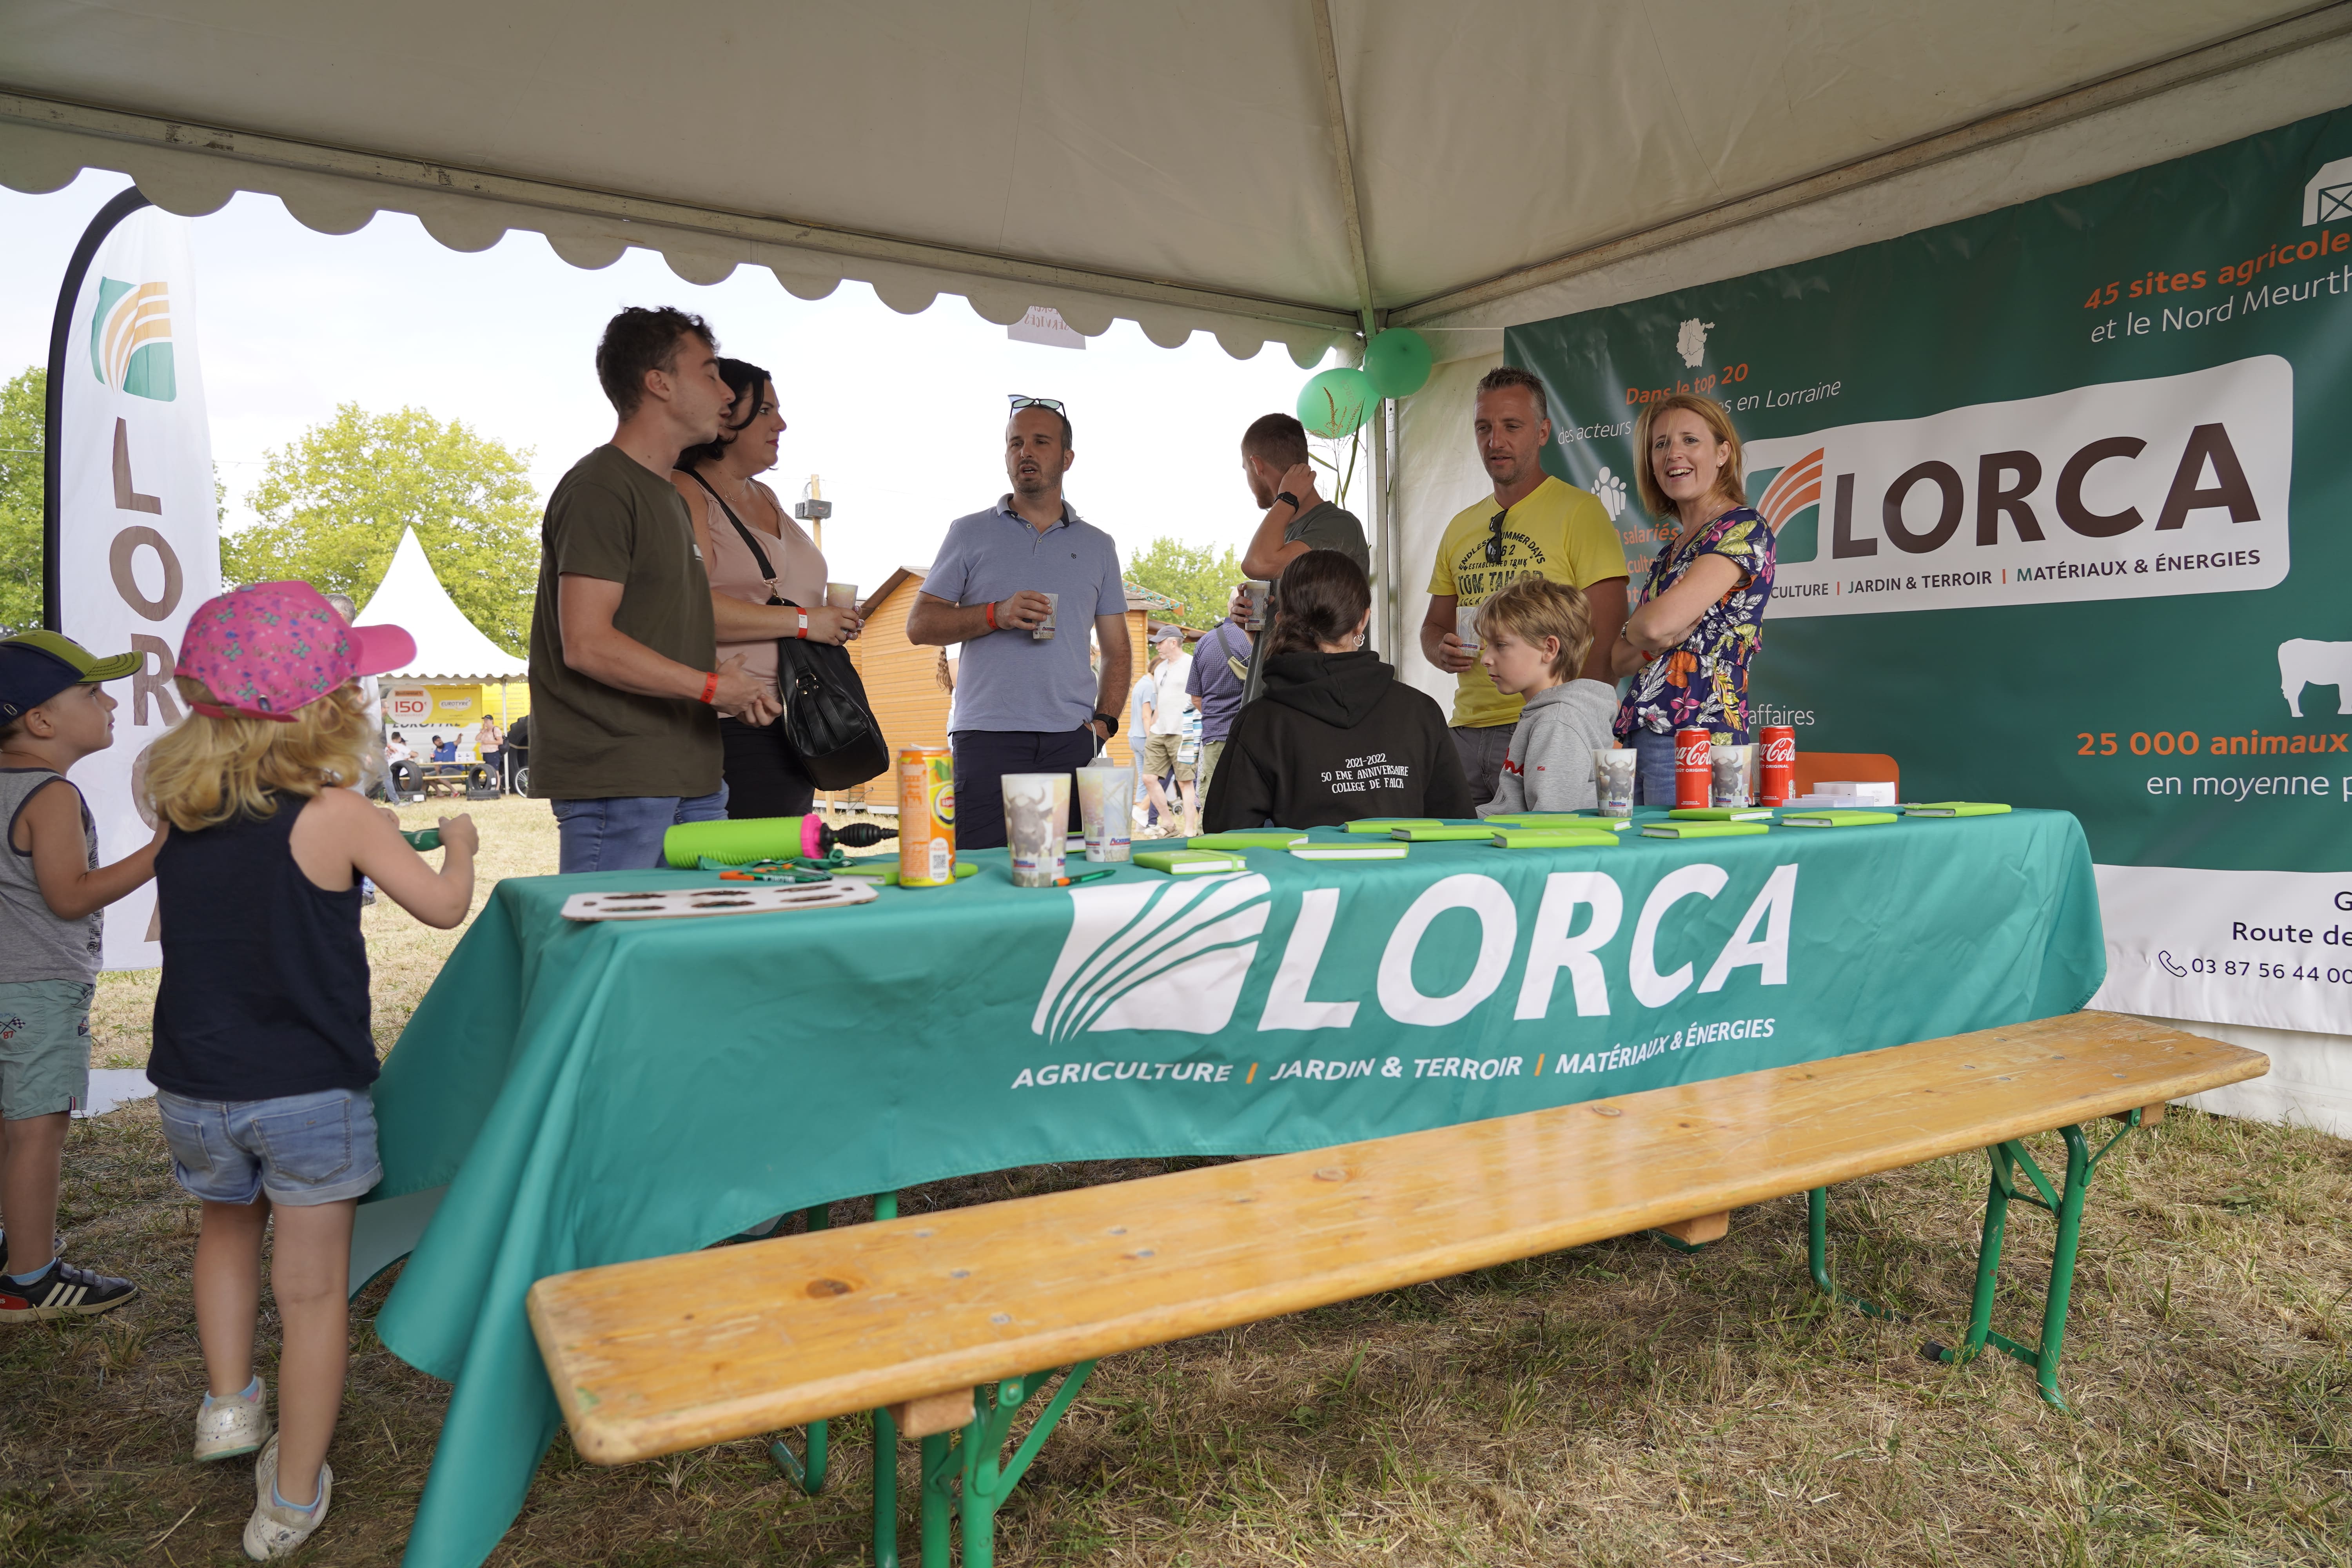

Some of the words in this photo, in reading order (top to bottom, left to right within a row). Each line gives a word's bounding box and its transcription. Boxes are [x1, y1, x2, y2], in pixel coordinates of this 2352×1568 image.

[2084, 281, 2120, 309] 45
[2129, 271, 2206, 298] sites
[2092, 319, 2117, 342] et
[2127, 312, 2150, 336] le
[2163, 296, 2233, 331] Nord
[1626, 387, 1671, 405] Dans
[1676, 380, 1690, 394] le
[1694, 374, 1716, 394] top
[1721, 364, 1748, 385] 20
[1737, 396, 1759, 410] en
[1766, 381, 1840, 407] Lorraine
[1558, 428, 1574, 444] des
[1577, 420, 1631, 440] acteurs
[1832, 423, 2261, 559] LORCA
[1623, 523, 1679, 545] salariés
[1501, 531, 1530, 545] UMMER
[1528, 541, 1545, 564] DAYS
[1458, 573, 1484, 595] TOM
[1771, 583, 1828, 599] CULTURE
[1848, 578, 1900, 593] JARDIN
[1906, 577, 1916, 589] &
[1922, 572, 1992, 588] TERROIR
[2017, 561, 2127, 581] MATÉRIAUX
[2134, 559, 2148, 573] &
[2156, 550, 2260, 572] ÉNERGIES
[2077, 733, 2117, 755] 25
[2130, 731, 2199, 755] 000
[2210, 730, 2348, 755] animaux
[1321, 772, 1332, 782] 50
[1336, 771, 1353, 780] EME
[1356, 764, 1408, 780] ANNIVERSAIRE
[1345, 753, 1387, 768] 2021-2022
[1332, 782, 1366, 793] COLLEGE
[1369, 779, 1381, 789] DE
[1384, 778, 1404, 788] FALCK
[2147, 777, 2181, 794] en
[2194, 777, 2329, 802] moyenne
[2233, 922, 2312, 943] Route
[1257, 863, 1798, 1031] LORCA
[2192, 958, 2216, 973] 03
[2225, 961, 2249, 975] 87
[2259, 964, 2284, 978] 56
[2293, 966, 2319, 981] 44
[2328, 968, 2352, 984] 00
[1011, 1062, 1233, 1089] AGRICULTURE
[1270, 1058, 1375, 1080] JARDIN
[1381, 1057, 1402, 1077] &
[1414, 1056, 1523, 1080] TERROIR
[1555, 1035, 1667, 1074] MATÉRIAUX
[1670, 1031, 1682, 1050] &
[1685, 1018, 1775, 1047] ÉNERGIES
